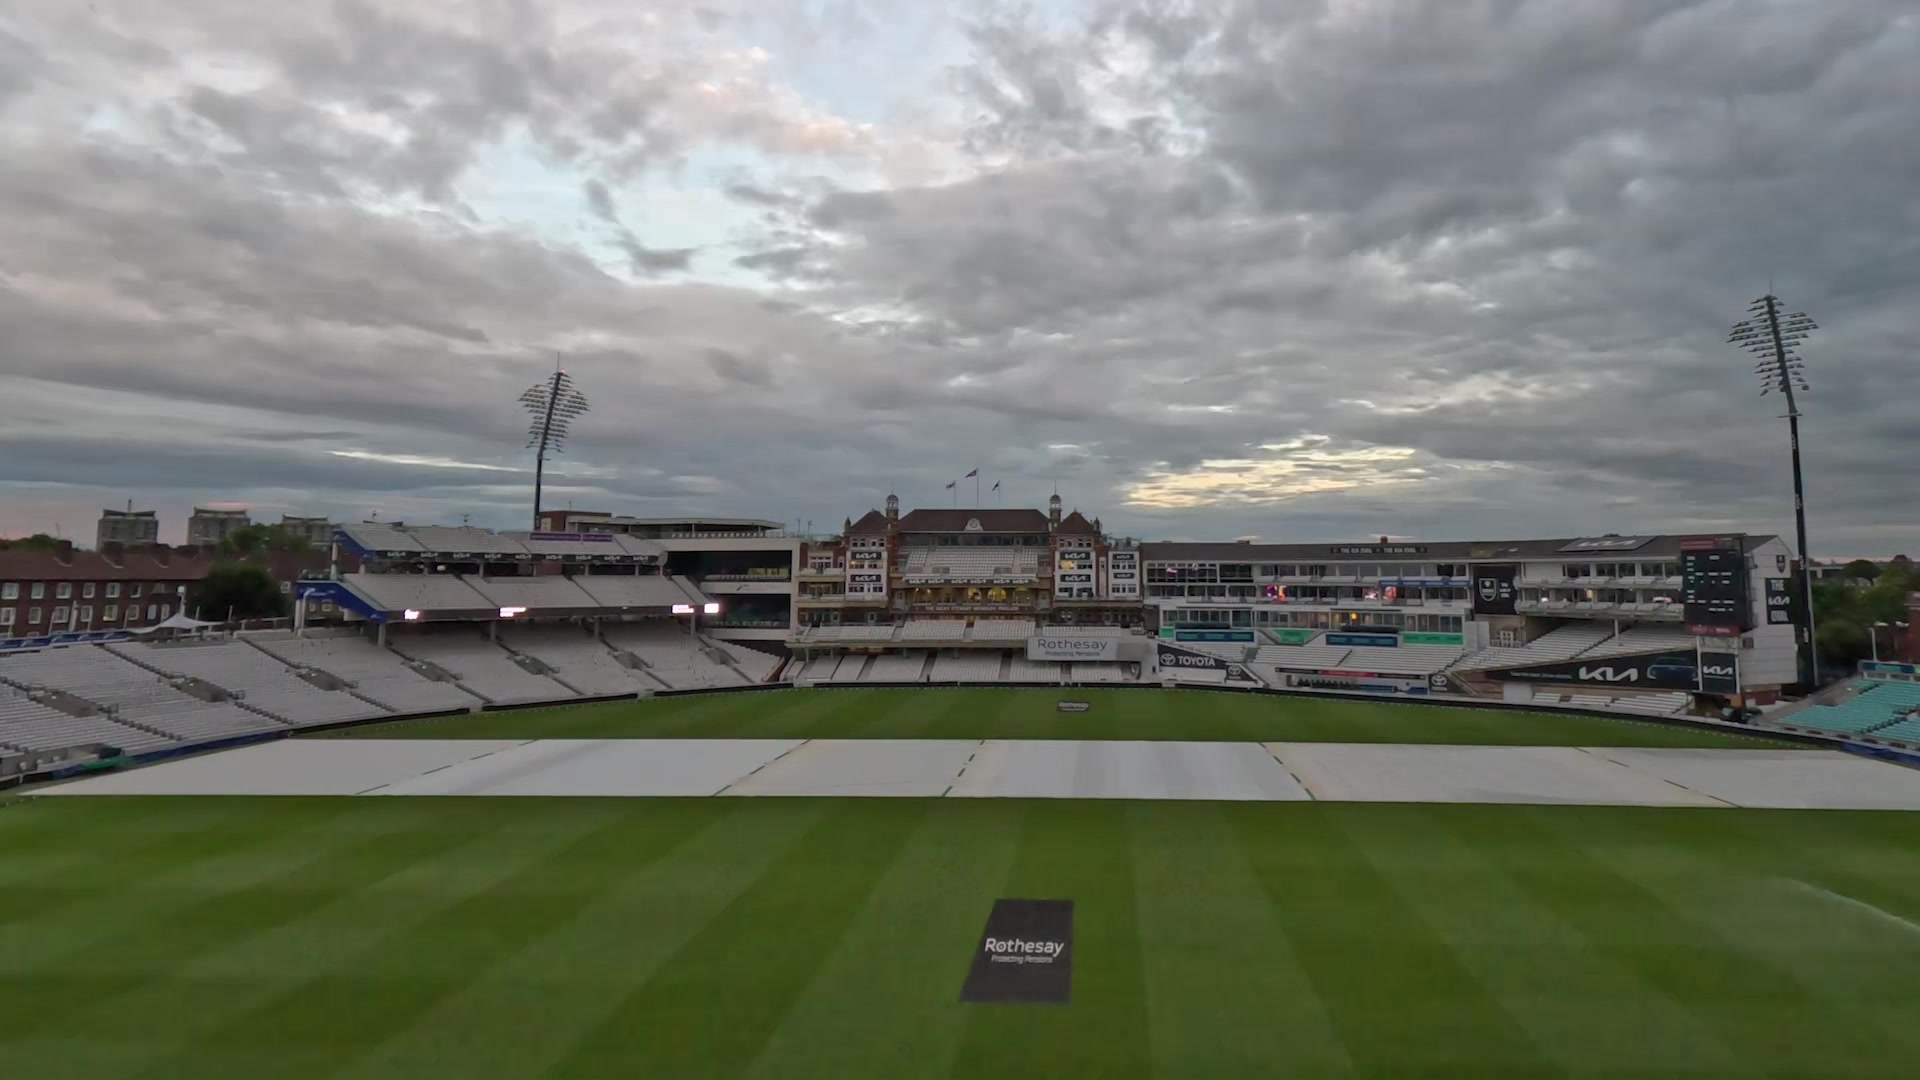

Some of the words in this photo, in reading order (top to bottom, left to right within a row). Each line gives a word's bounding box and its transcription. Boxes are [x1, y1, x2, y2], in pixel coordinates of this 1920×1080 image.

[1770, 579, 1785, 591] THE
[1768, 595, 1790, 605] KIA
[1037, 638, 1108, 651] Rothesay
[1177, 655, 1216, 667] TOYOTA
[1578, 666, 1639, 682] KIA
[1703, 665, 1733, 675] KIA
[984, 937, 1065, 957] Rothesay
[991, 954, 1024, 965] Protecting
[1025, 955, 1053, 964] Pensions
